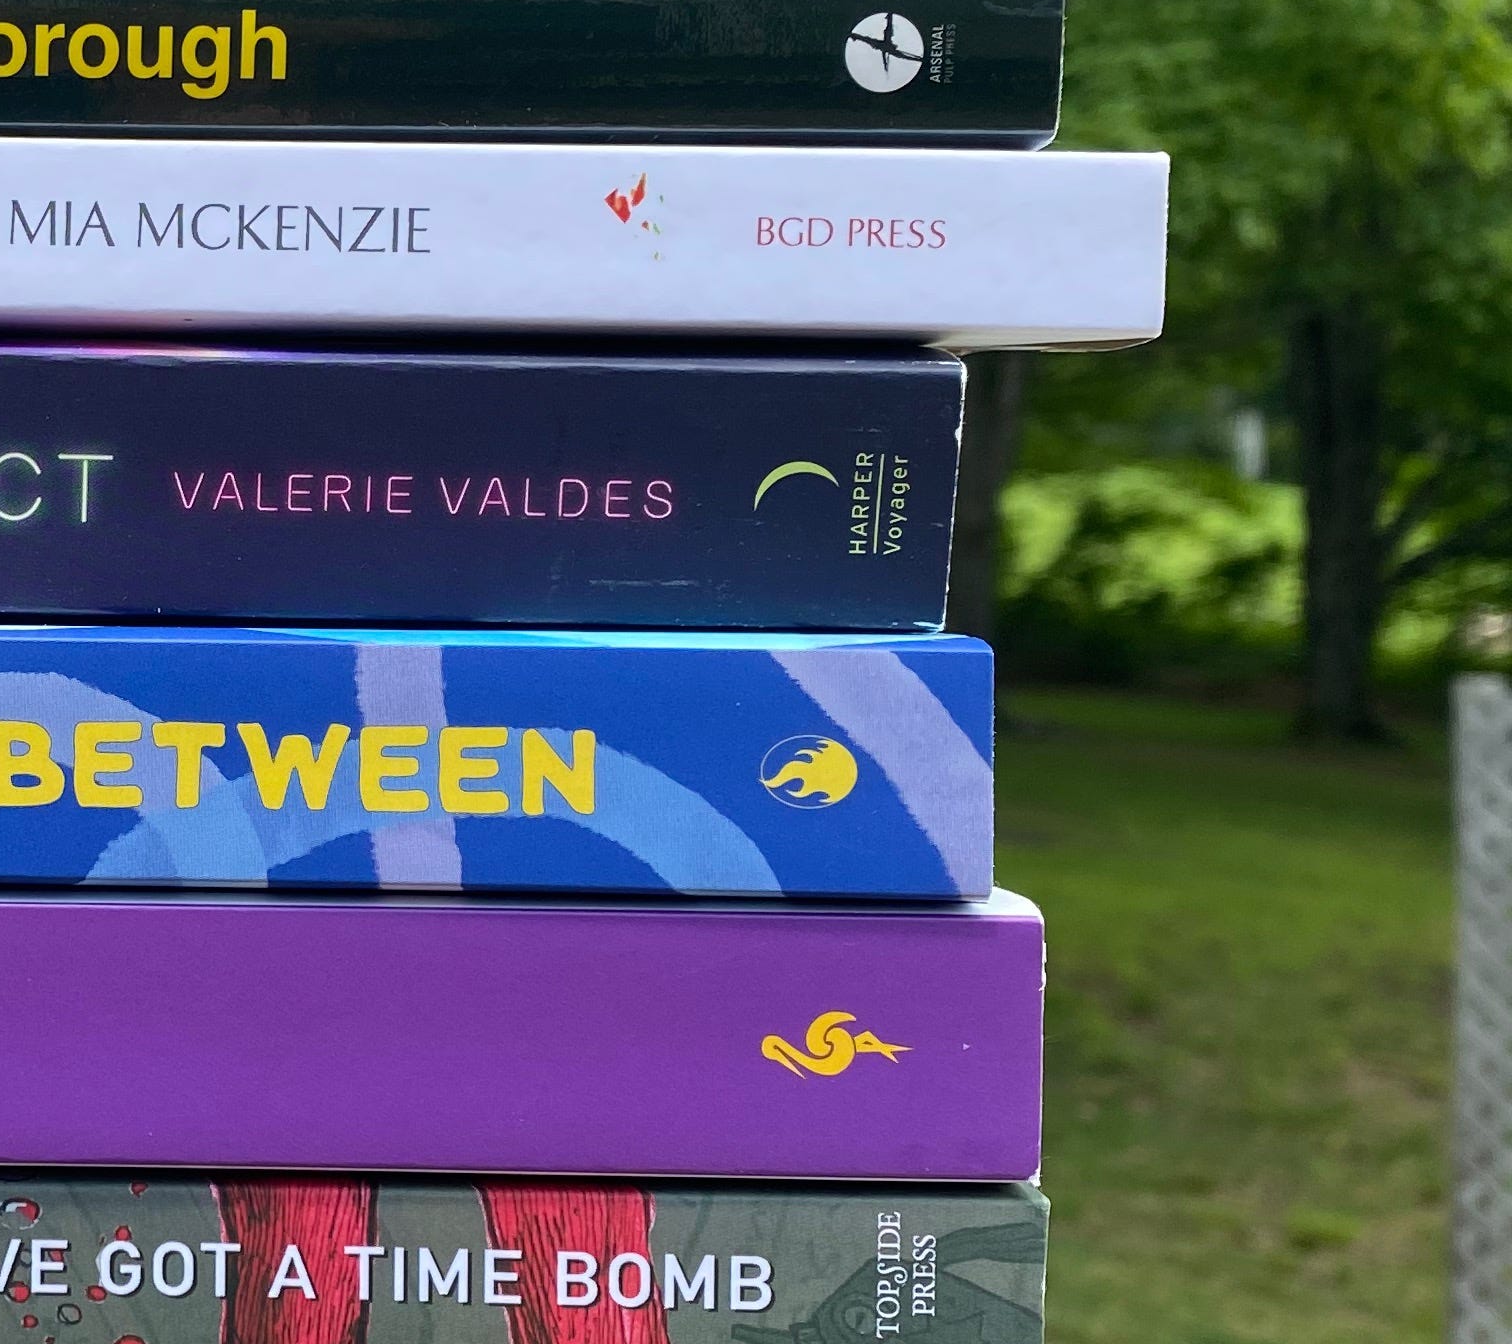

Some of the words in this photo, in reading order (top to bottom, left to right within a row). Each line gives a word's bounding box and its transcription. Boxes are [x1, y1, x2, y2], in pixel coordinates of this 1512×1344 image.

[930, 24, 944, 83] ARSENAL
[8, 199, 114, 249] MIA
[135, 202, 432, 255] MCKENZIE
[755, 216, 833, 249] BGD
[847, 217, 948, 252] PRESS
[171, 471, 414, 516] VALERIE
[439, 477, 674, 520] VALDES
[849, 452, 874, 555] HARPER
[883, 455, 911, 556] Voyager
[96, 1240, 242, 1302] GOT
[266, 1244, 320, 1302] A
[343, 1244, 524, 1307] TIME
[555, 1250, 776, 1314] BOMB
[876, 1211, 909, 1339] TOPSIDE
[912, 1234, 937, 1317] PRESS
